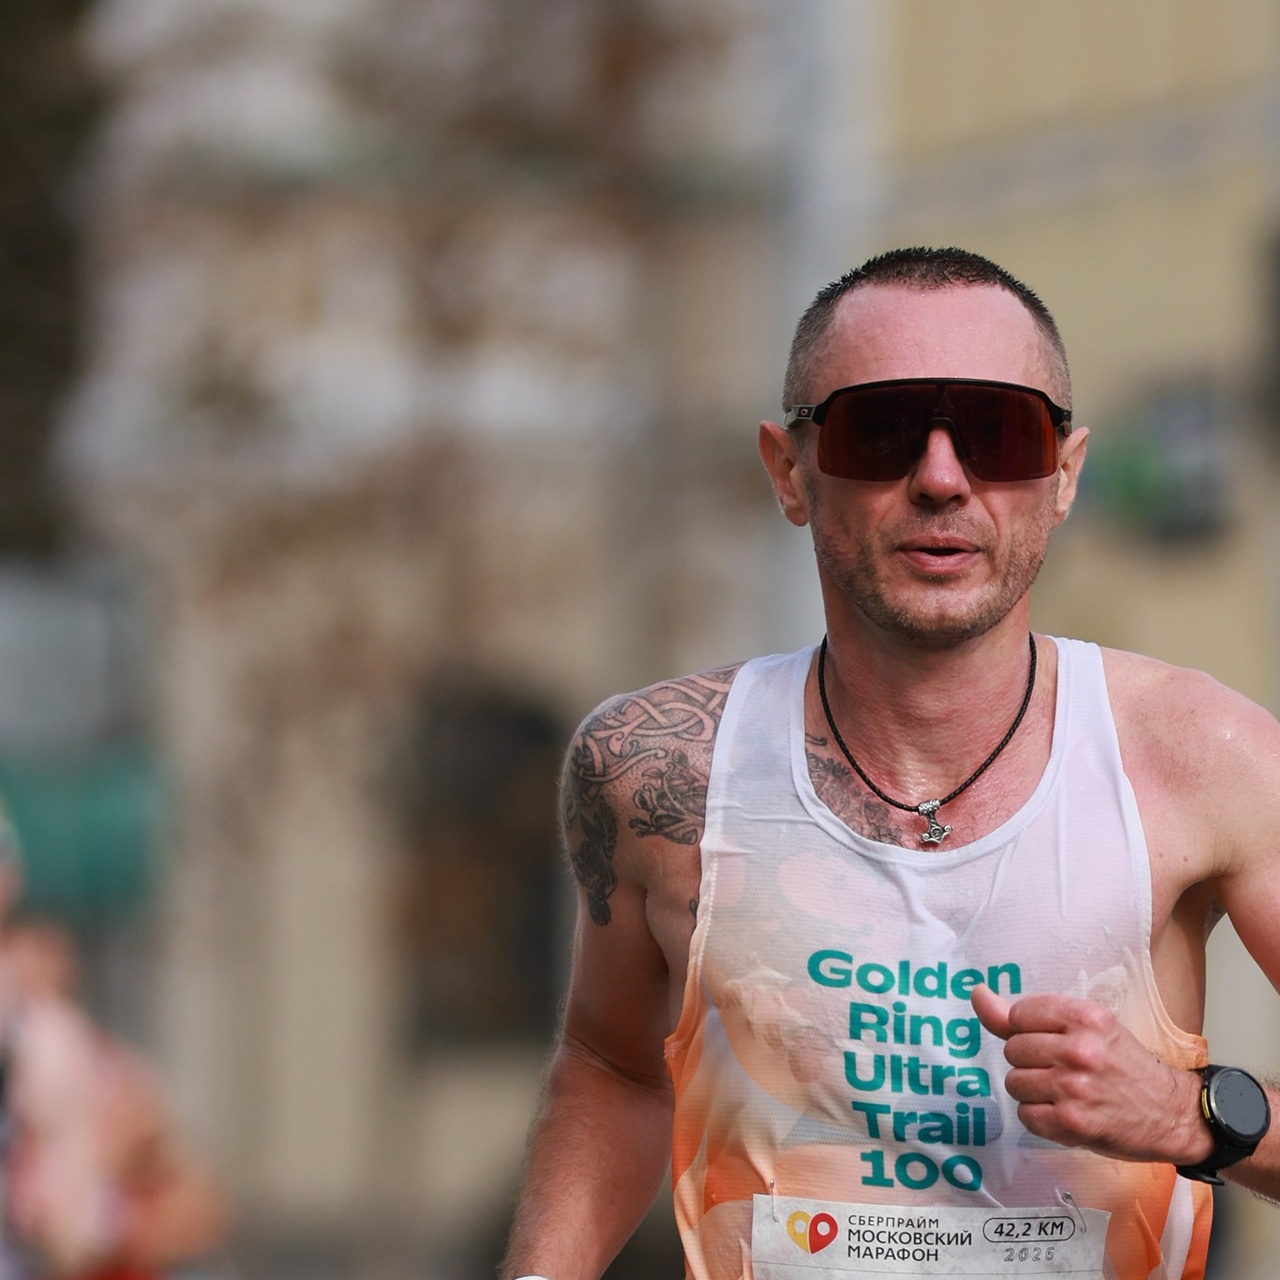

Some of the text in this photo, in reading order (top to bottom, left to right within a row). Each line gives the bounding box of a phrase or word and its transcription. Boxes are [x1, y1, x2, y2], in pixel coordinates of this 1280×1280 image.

[807, 949, 1022, 1001] Golden
[849, 1001, 981, 1059] Ring
[844, 1051, 991, 1097] Ultra
[852, 1101, 986, 1147] Trail
[860, 1150, 982, 1191] 100
[847, 1228, 972, 1246] МОСКОВСКИЙ
[848, 1214, 939, 1229] СБЕРПРАЙМ
[994, 1222, 1032, 1239] 42,2
[847, 1245, 939, 1262] МАРАФОН
